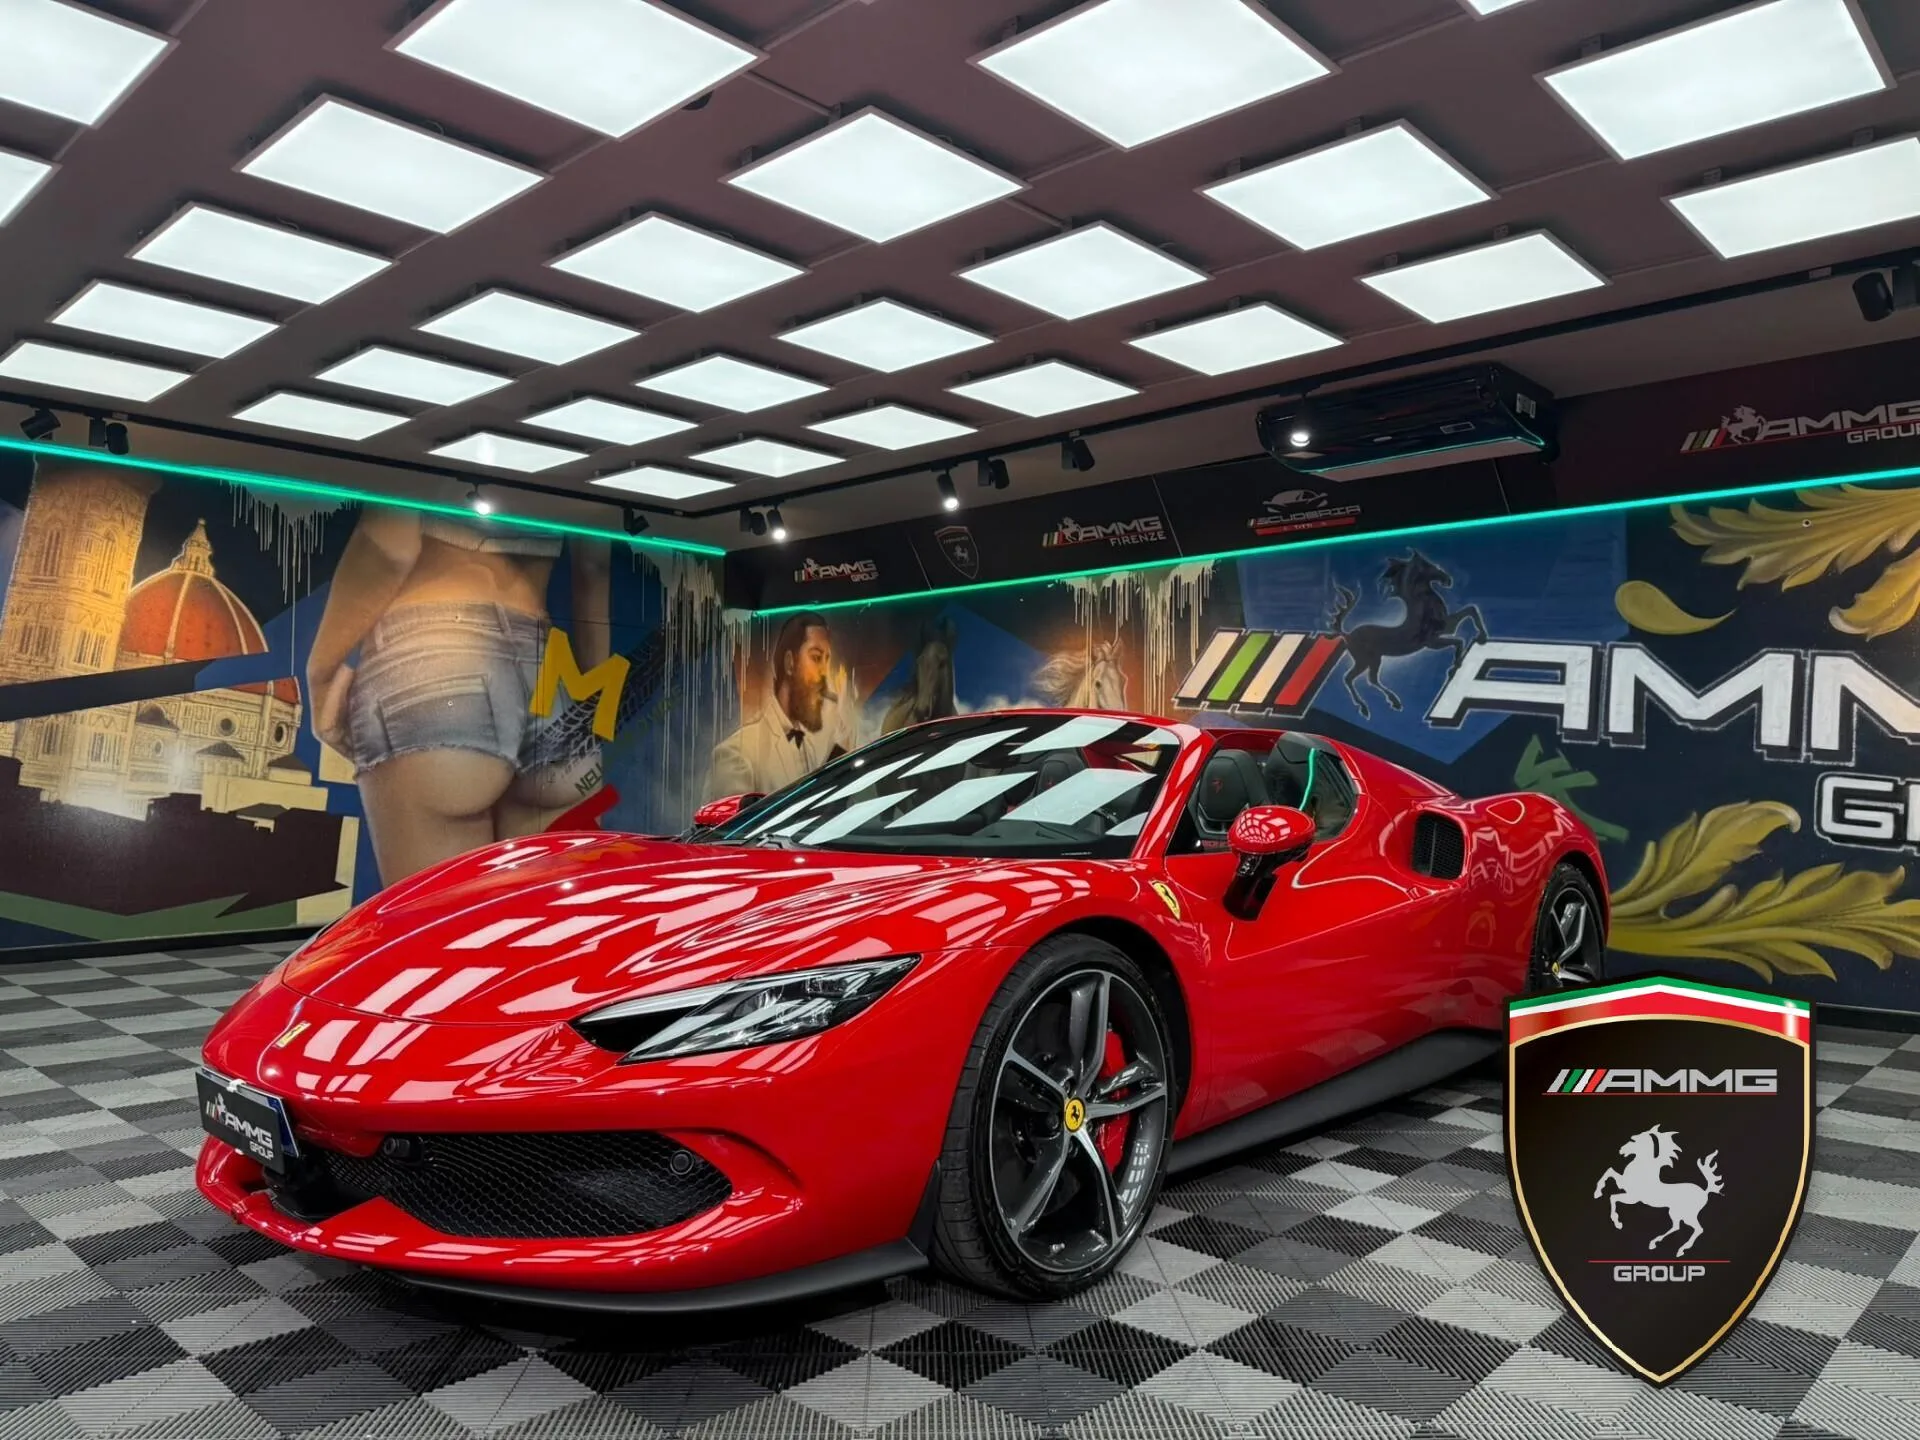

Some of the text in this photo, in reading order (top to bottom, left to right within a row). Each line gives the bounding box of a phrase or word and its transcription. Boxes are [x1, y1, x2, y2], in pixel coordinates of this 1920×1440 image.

[1755, 400, 1920, 441] AMMG
[1846, 423, 1920, 444] GROU
[1256, 505, 1362, 525] SCUDERIA
[1078, 516, 1163, 541] AMMG
[1110, 530, 1168, 548] FIRENZE
[819, 559, 877, 578] AMMG
[850, 571, 879, 582] GROUP
[529, 627, 631, 742] M
[225, 1112, 273, 1148] AMMG
[249, 1140, 274, 1160] GROUP
